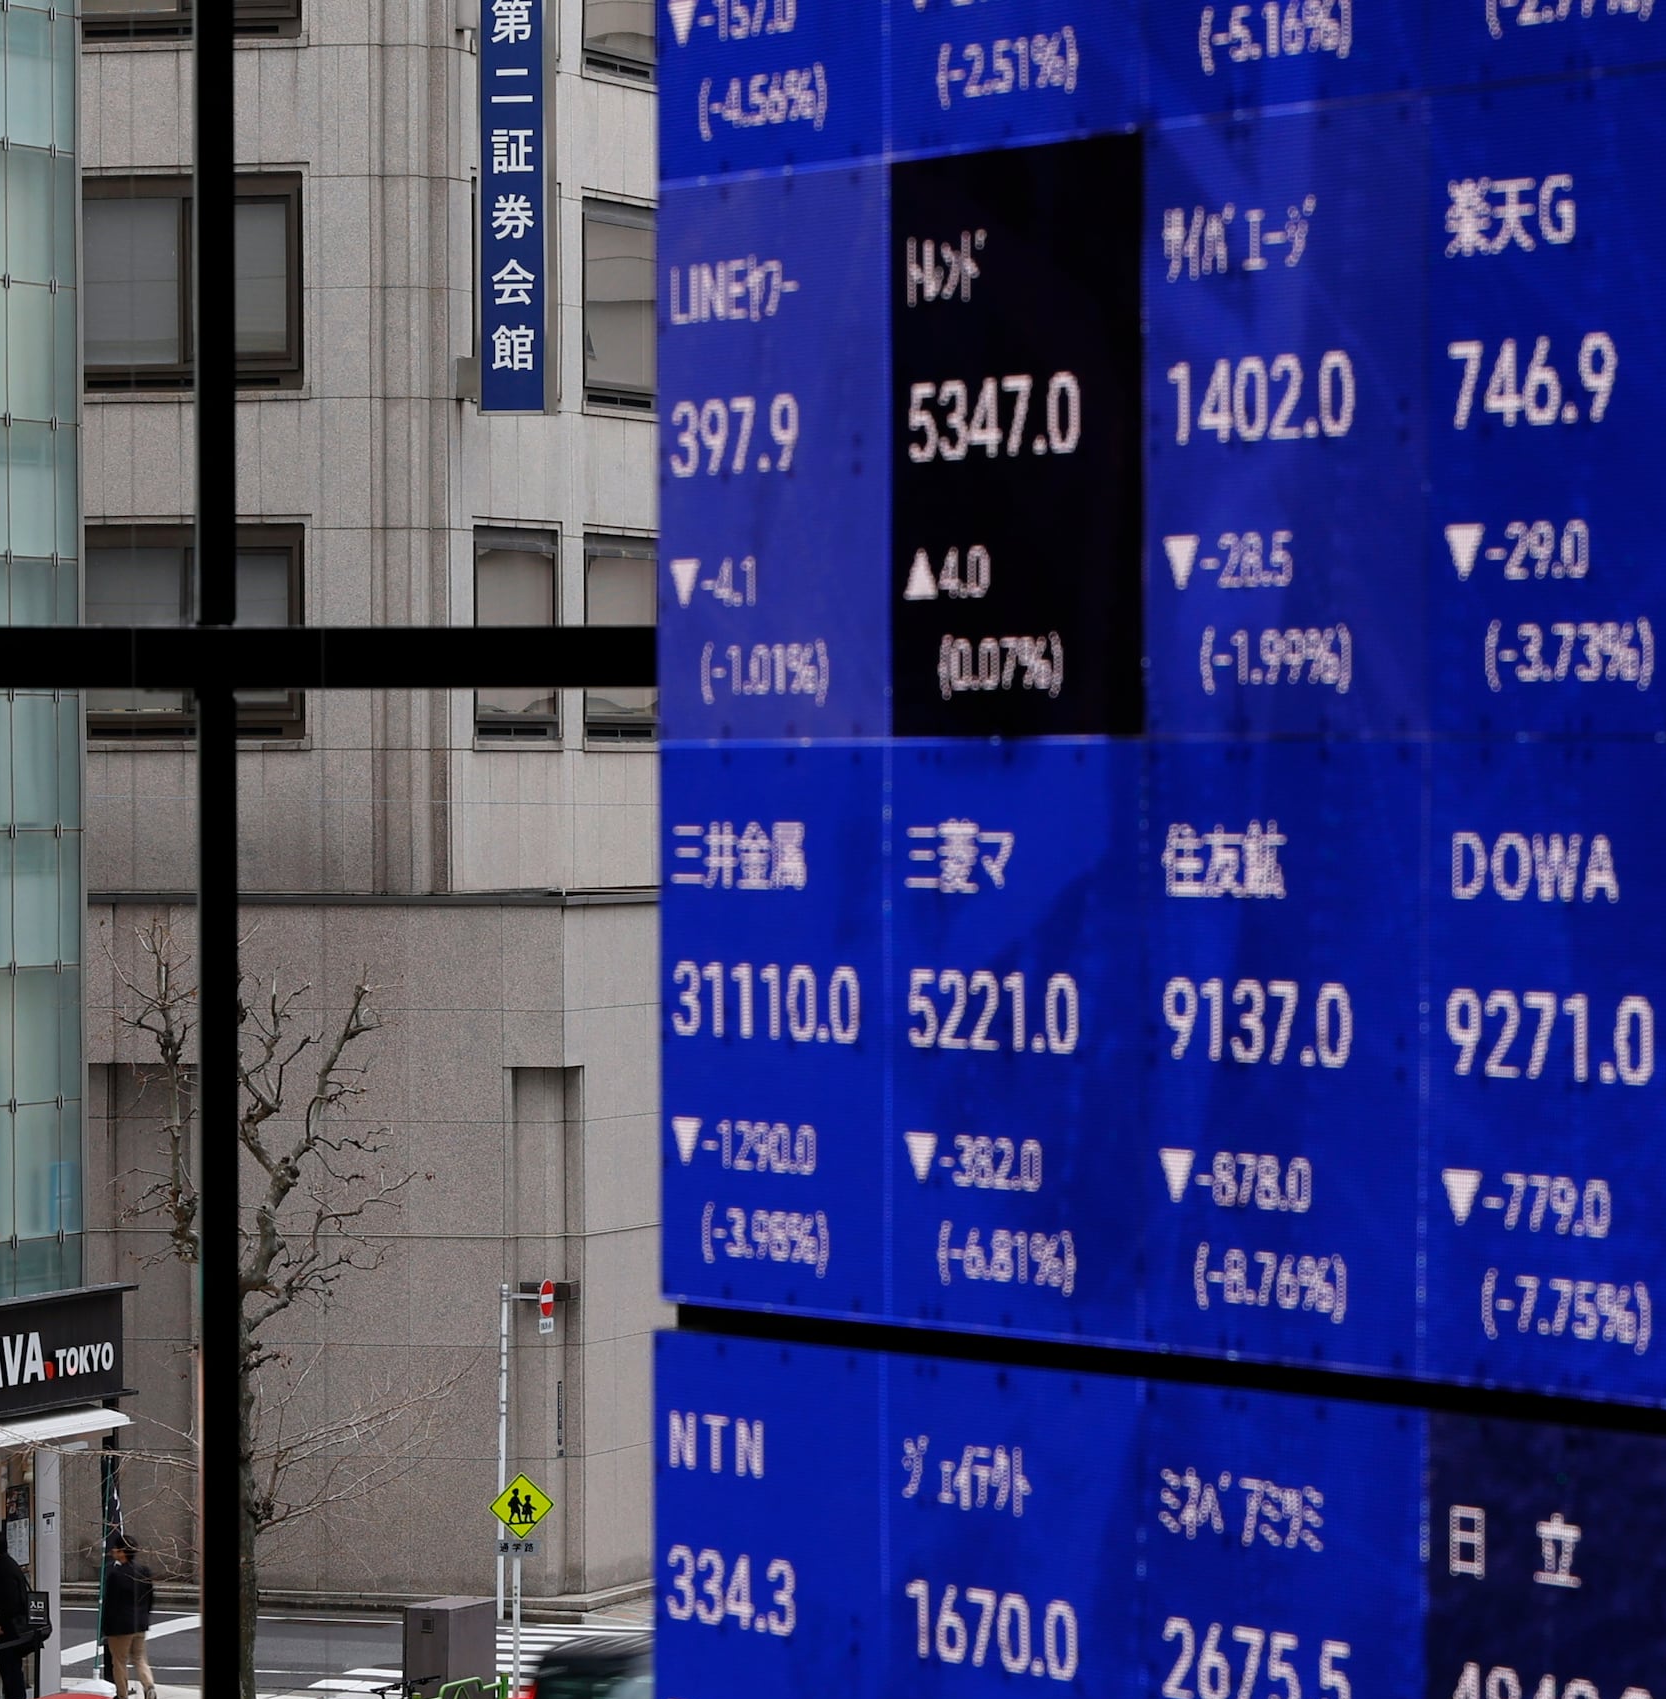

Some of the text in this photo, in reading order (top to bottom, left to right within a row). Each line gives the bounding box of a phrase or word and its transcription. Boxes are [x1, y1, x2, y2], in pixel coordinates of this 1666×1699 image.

[491, 0, 535, 371] 第二証券会館
[1447, 175, 1575, 256] 楽天G
[909, 372, 1079, 462] 5347.0
[1168, 351, 1355, 445] 1402.0
[1448, 333, 1617, 429] 746.9
[671, 394, 798, 477] 397.9
[939, 545, 991, 599] 4.0
[1488, 520, 1588, 579] -29.0
[673, 822, 806, 889] 三井金属
[1452, 833, 1618, 901] DOWA
[673, 961, 859, 1043] 31110.0
[909, 969, 1078, 1054] 5221.0
[1163, 977, 1352, 1068] 9137.0
[1446, 989, 1653, 1085] 9271.0
[1197, 1152, 1311, 1212] -878.0
[1484, 1173, 1610, 1238] -779.0
[1195, 1246, 1346, 1323] (-8.76%)
[1482, 1272, 1650, 1351] (-7.75%)
[55, 1341, 114, 1378] TOKYO
[669, 1411, 763, 1478] NTN
[499, 1542, 534, 1553] 通学路
[667, 1545, 795, 1636] 334.3
[906, 1580, 1077, 1680] 1670.0
